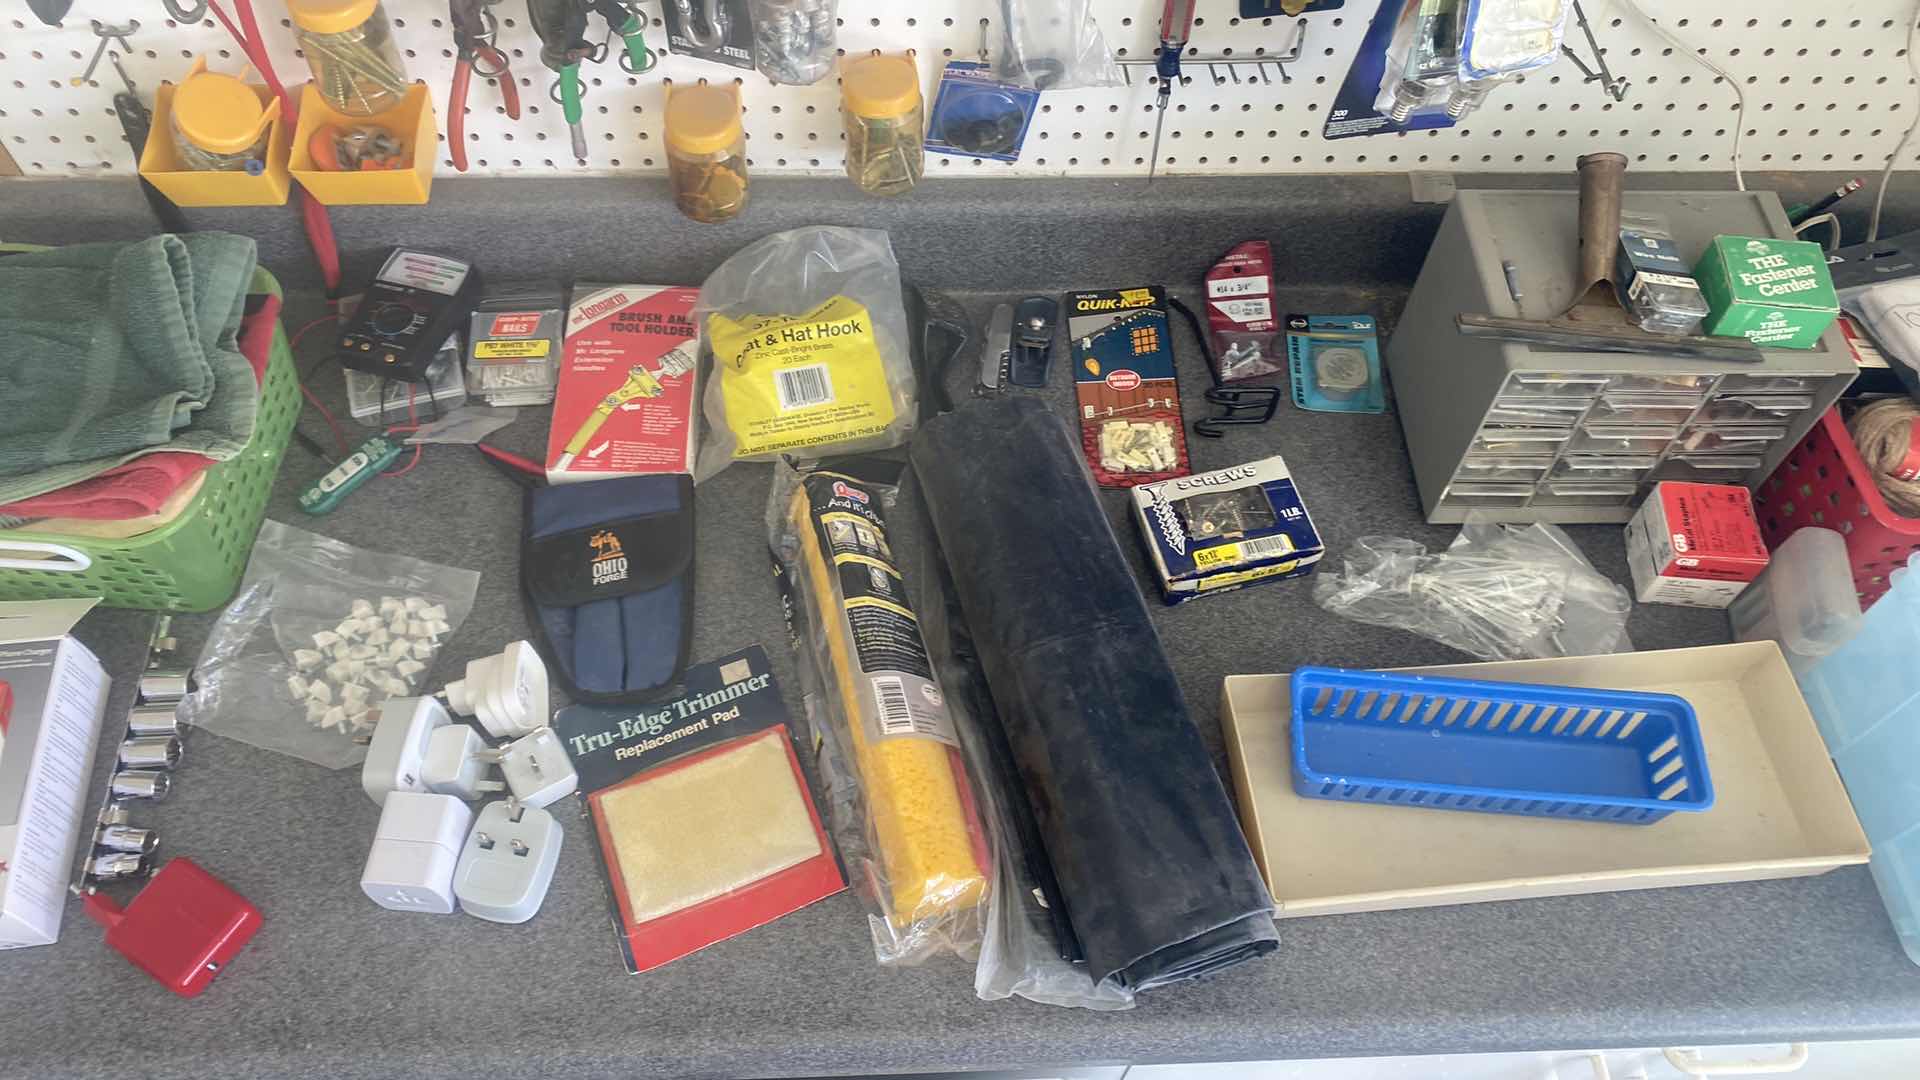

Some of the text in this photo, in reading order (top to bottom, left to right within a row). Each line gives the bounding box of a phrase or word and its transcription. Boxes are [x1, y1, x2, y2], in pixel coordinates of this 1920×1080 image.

[723, 46, 751, 60] STEEL
[1747, 254, 1789, 271] THE
[1740, 264, 1817, 287] Fastener
[1758, 277, 1819, 297] Center
[1077, 296, 1156, 311] QUIK-KP
[619, 312, 661, 322] BRUSH
[1760, 320, 1788, 330] THE
[610, 323, 696, 337] TOOL HOLDER
[766, 334, 778, 346] &
[781, 327, 813, 343] Hat
[816, 320, 863, 339] Hook
[1744, 325, 1802, 337] Fastener
[1750, 333, 1795, 343] Center
[750, 445, 766, 453] NOT
[768, 439, 806, 450] SEPARATE
[807, 432, 848, 443] CONTENTS
[858, 427, 874, 436] THIS
[1177, 466, 1258, 490] SCREWS
[1673, 534, 1688, 552] GB
[592, 557, 628, 577] OHIO
[1675, 558, 1700, 567] GB
[592, 571, 630, 585] FORGE
[570, 672, 770, 756] Tru-Edge Trimmer
[615, 706, 740, 761] Replacement Pad
